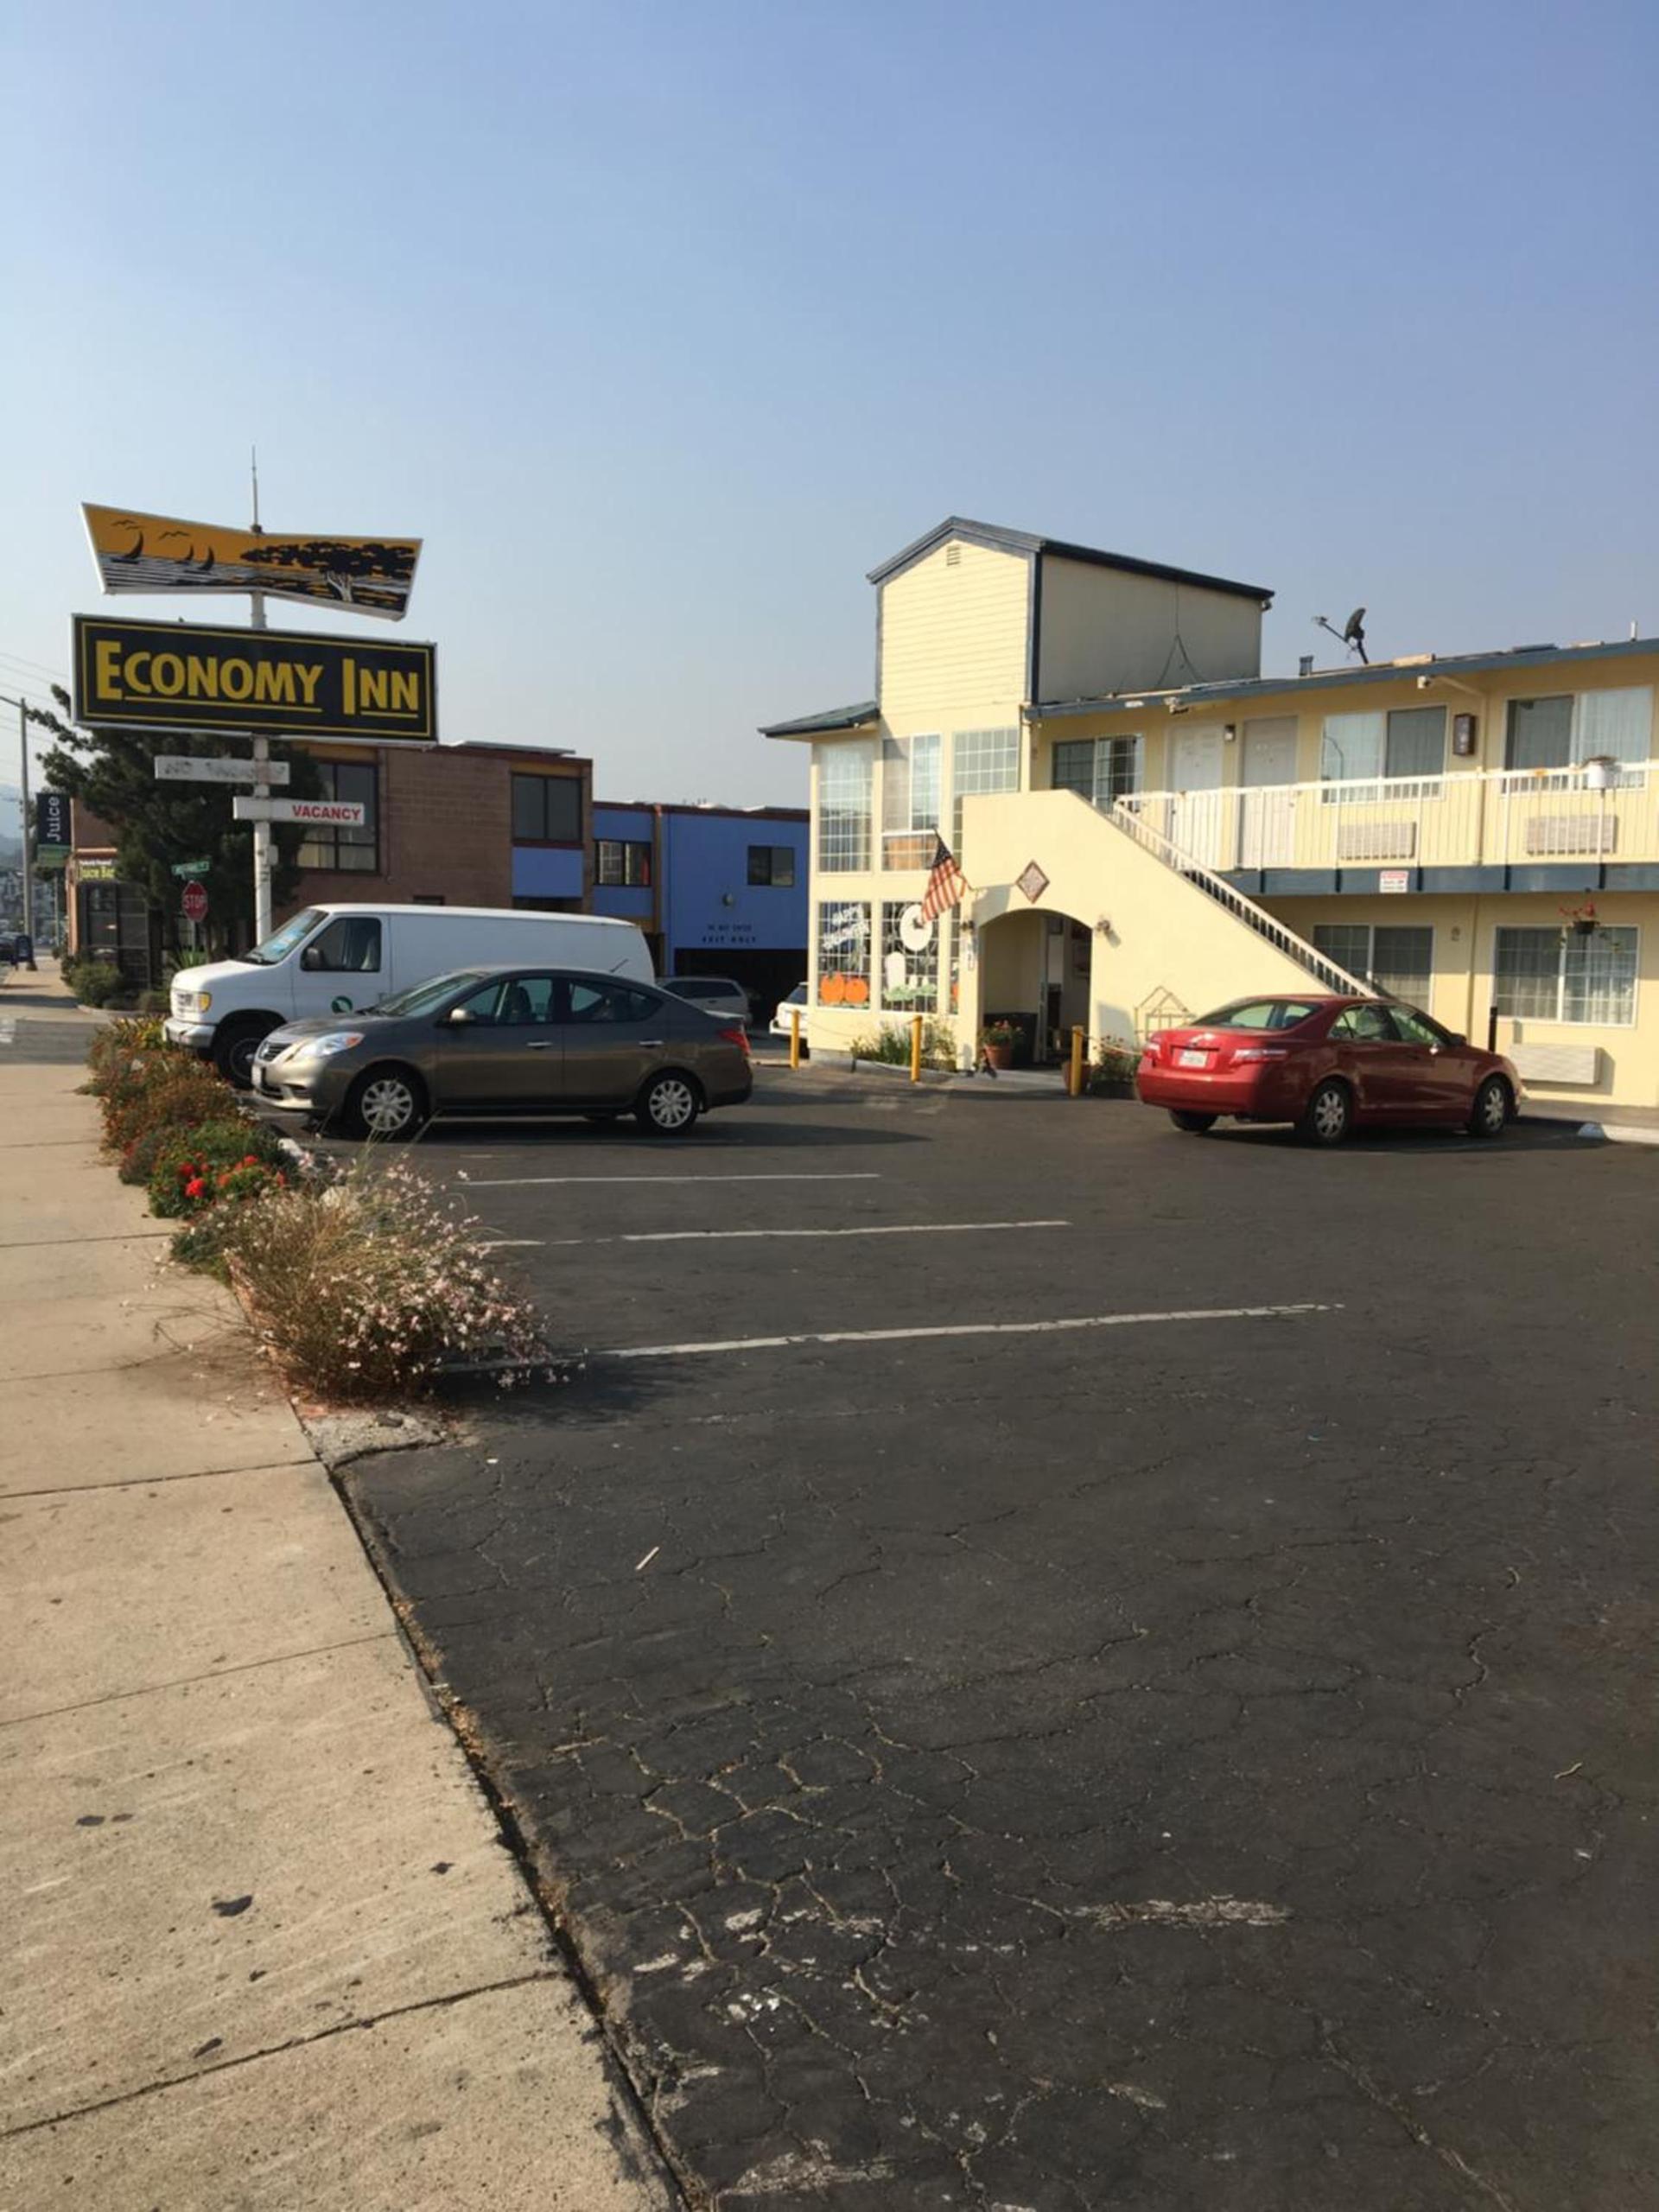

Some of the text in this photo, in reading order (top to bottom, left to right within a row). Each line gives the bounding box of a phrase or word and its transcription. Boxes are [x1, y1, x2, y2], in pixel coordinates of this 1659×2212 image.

[46, 796, 61, 842] Juice
[292, 805, 361, 821] VACANCY
[182, 894, 207, 909] STOP
